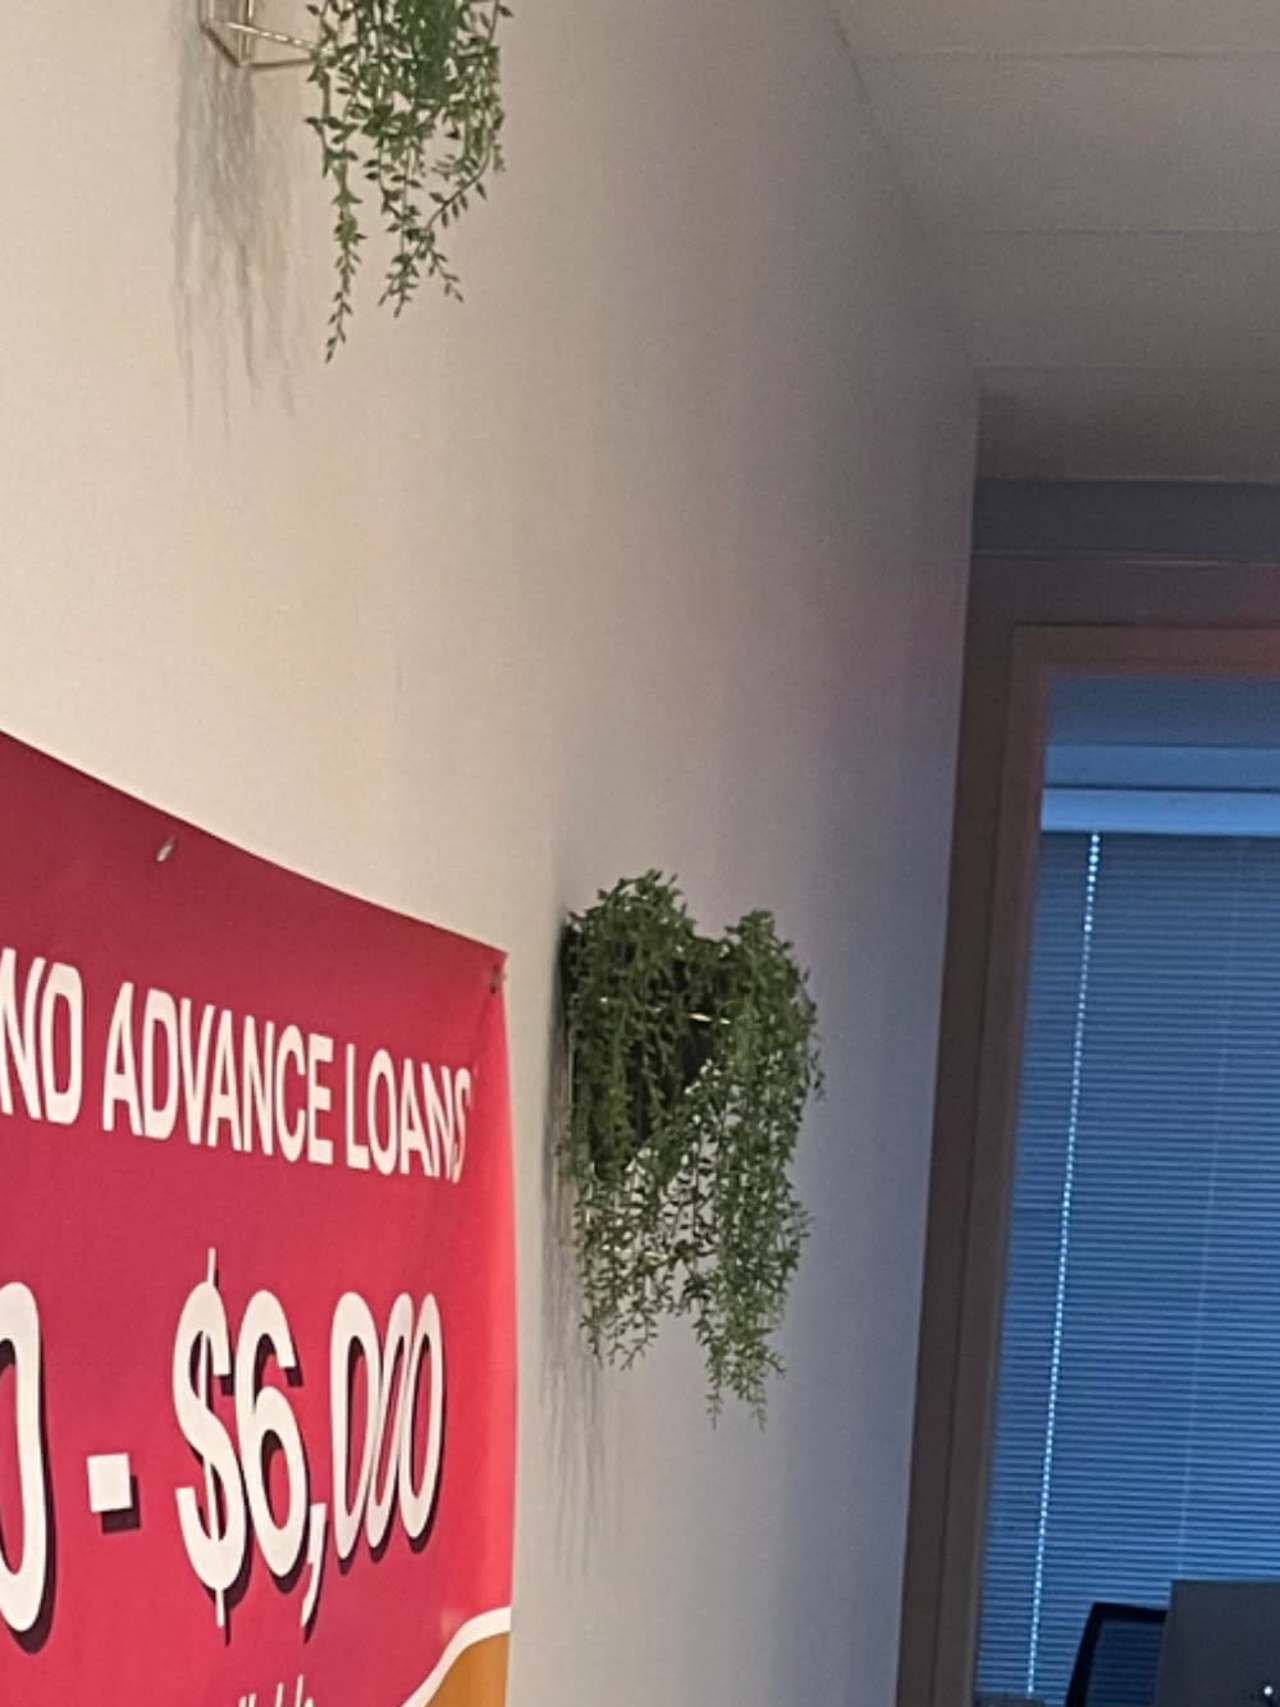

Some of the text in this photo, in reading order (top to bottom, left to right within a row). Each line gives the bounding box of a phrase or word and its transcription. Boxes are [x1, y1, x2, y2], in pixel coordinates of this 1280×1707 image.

[102, 982, 333, 1165] ADVANCE
[87, 1453, 132, 1513] -
[172, 1248, 443, 1627] $6,000
